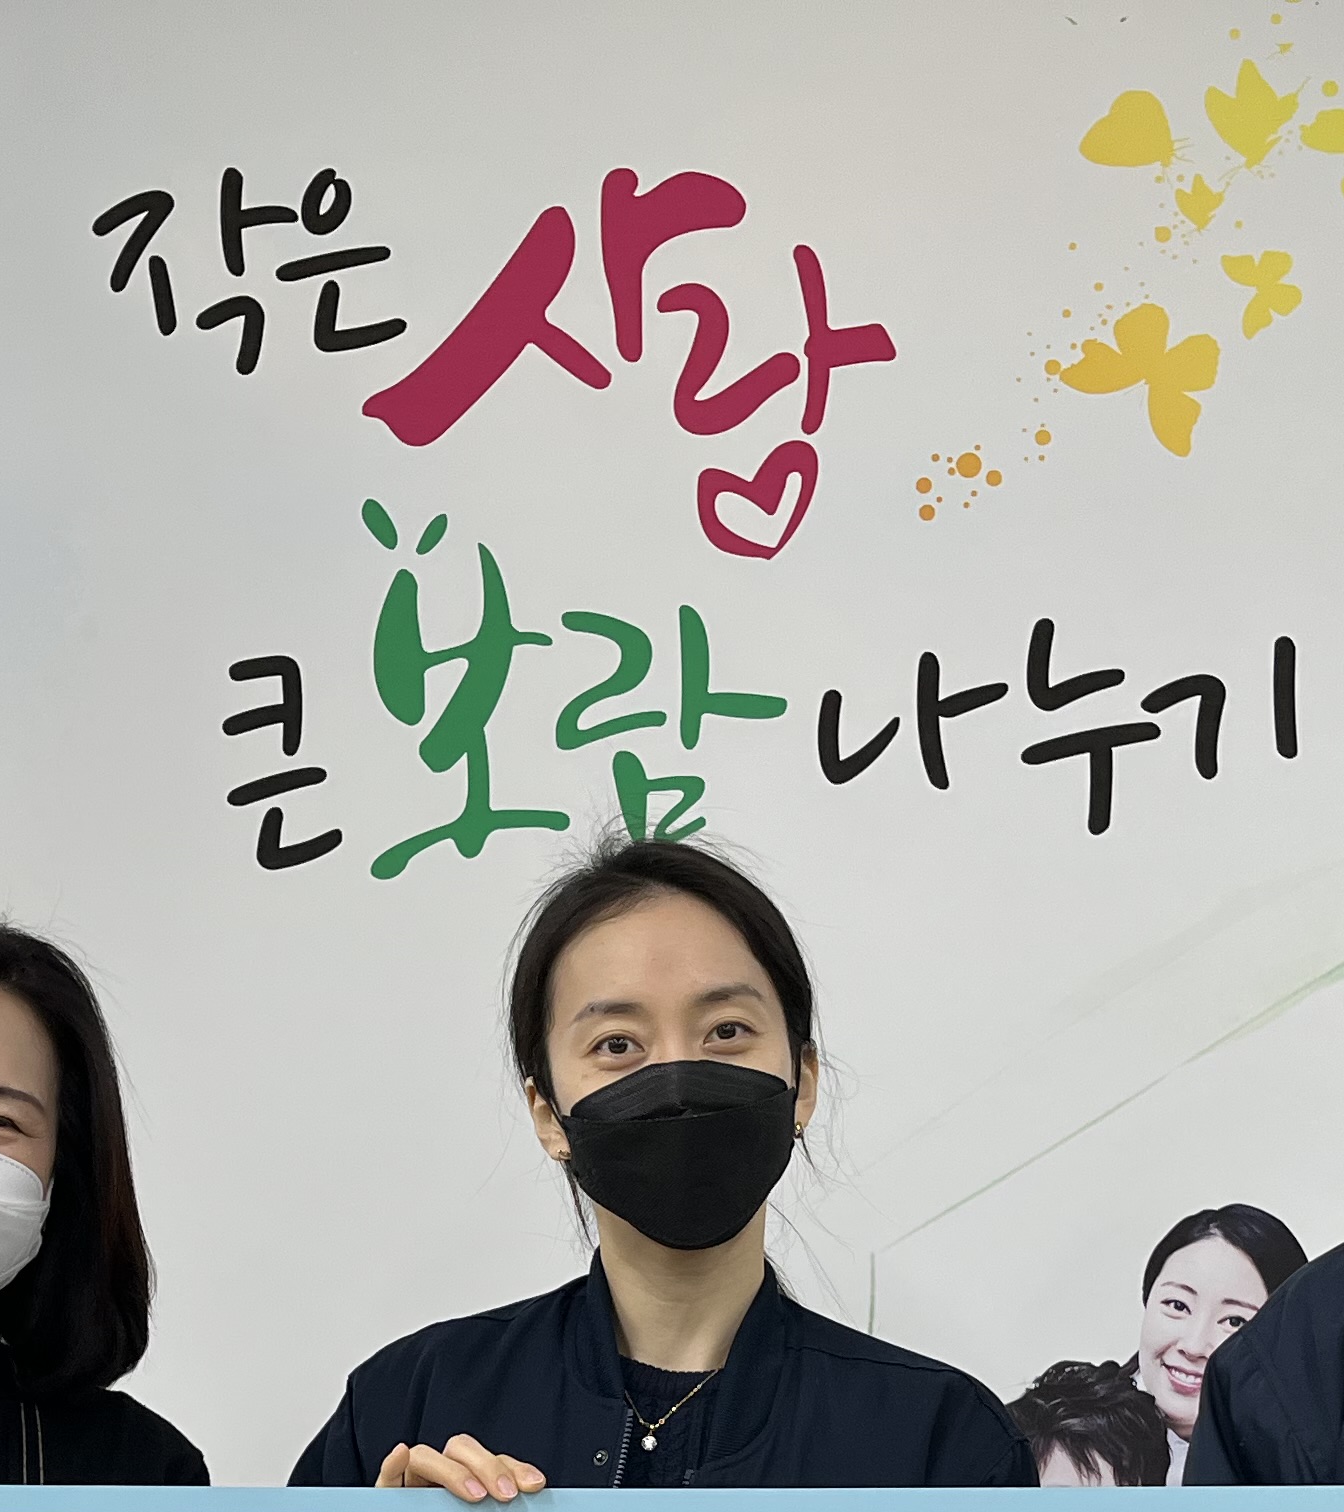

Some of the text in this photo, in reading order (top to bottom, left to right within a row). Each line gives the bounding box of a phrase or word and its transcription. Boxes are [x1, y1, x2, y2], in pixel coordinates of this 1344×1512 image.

[92, 166, 898, 561] 작은 사랑
[222, 498, 1299, 880] 큰 보람 나누기
